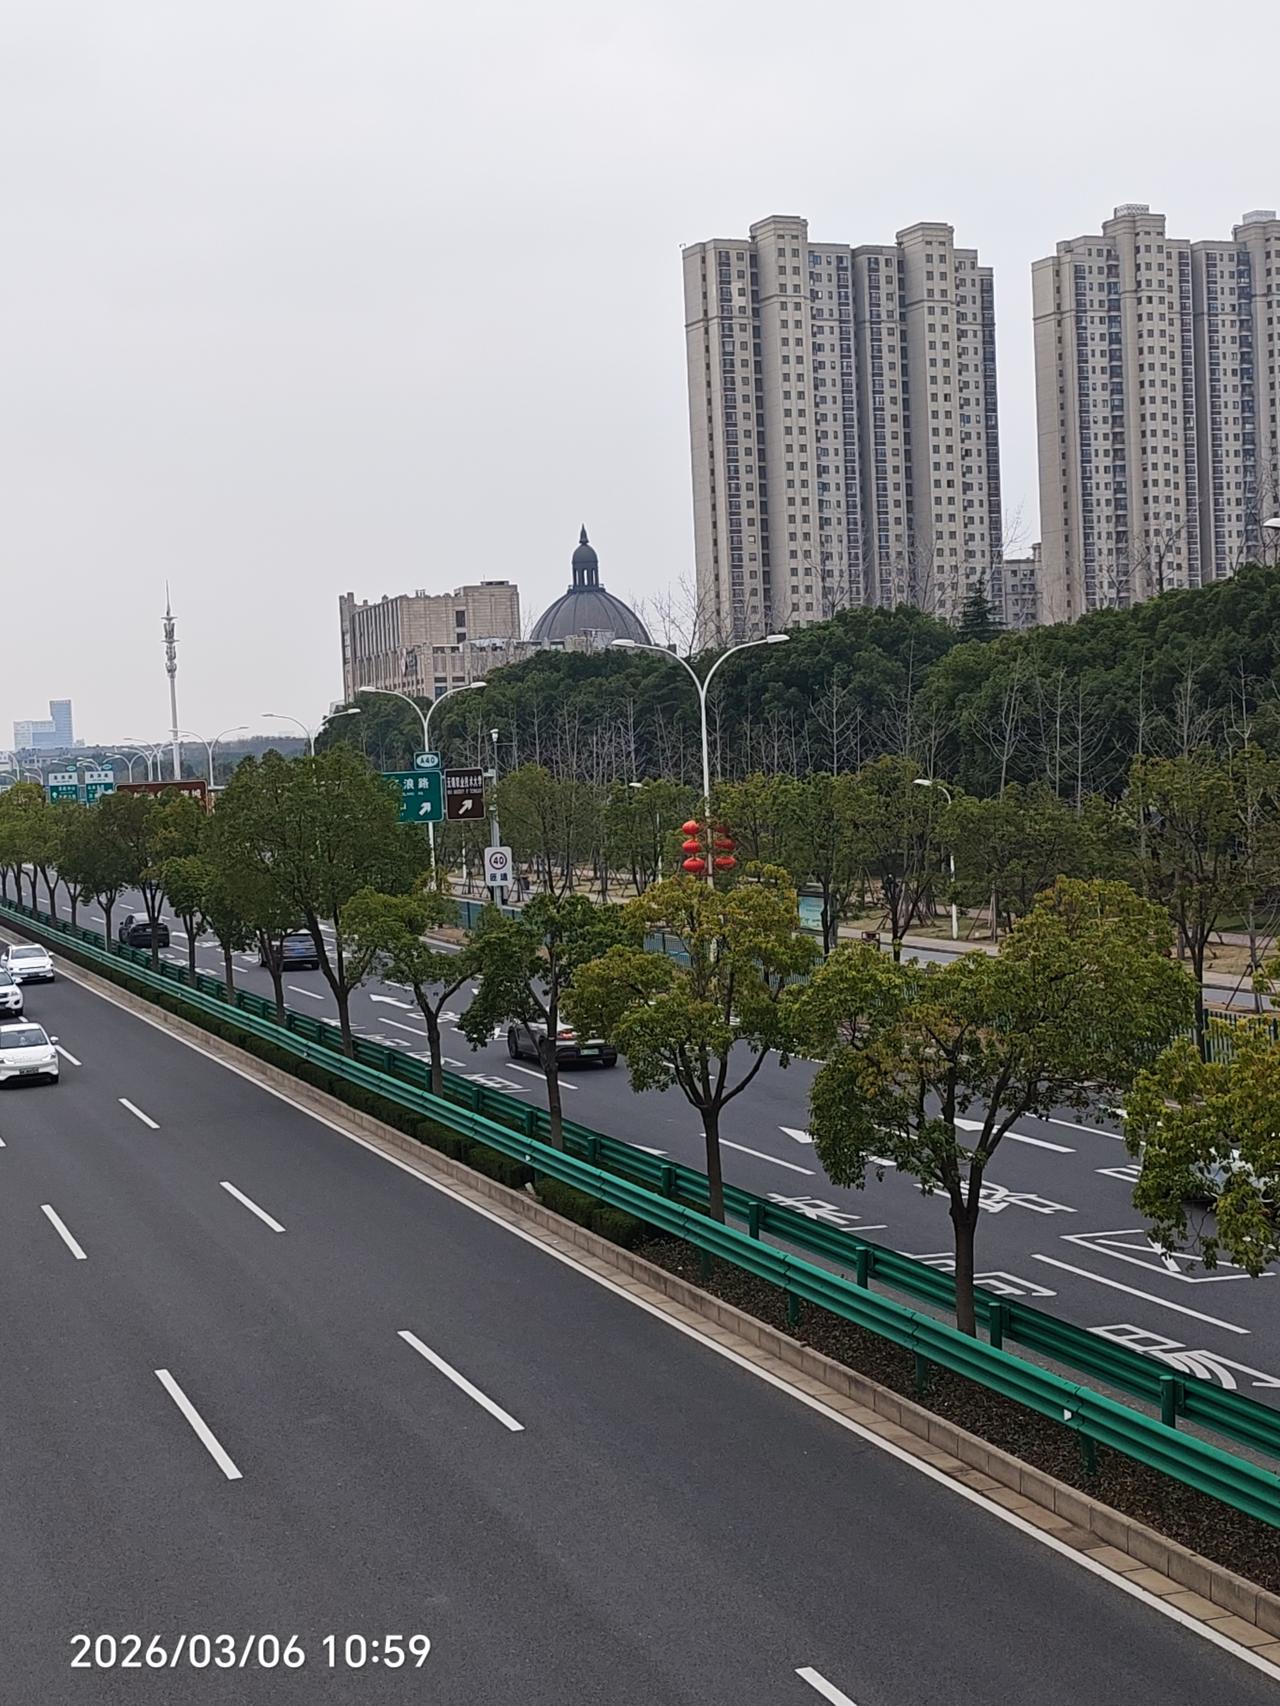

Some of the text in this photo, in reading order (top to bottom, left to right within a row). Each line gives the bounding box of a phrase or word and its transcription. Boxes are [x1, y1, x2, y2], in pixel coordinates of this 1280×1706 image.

[420, 756, 435, 764] A40
[395, 777, 429, 790] 浪路
[493, 856, 504, 865] 40
